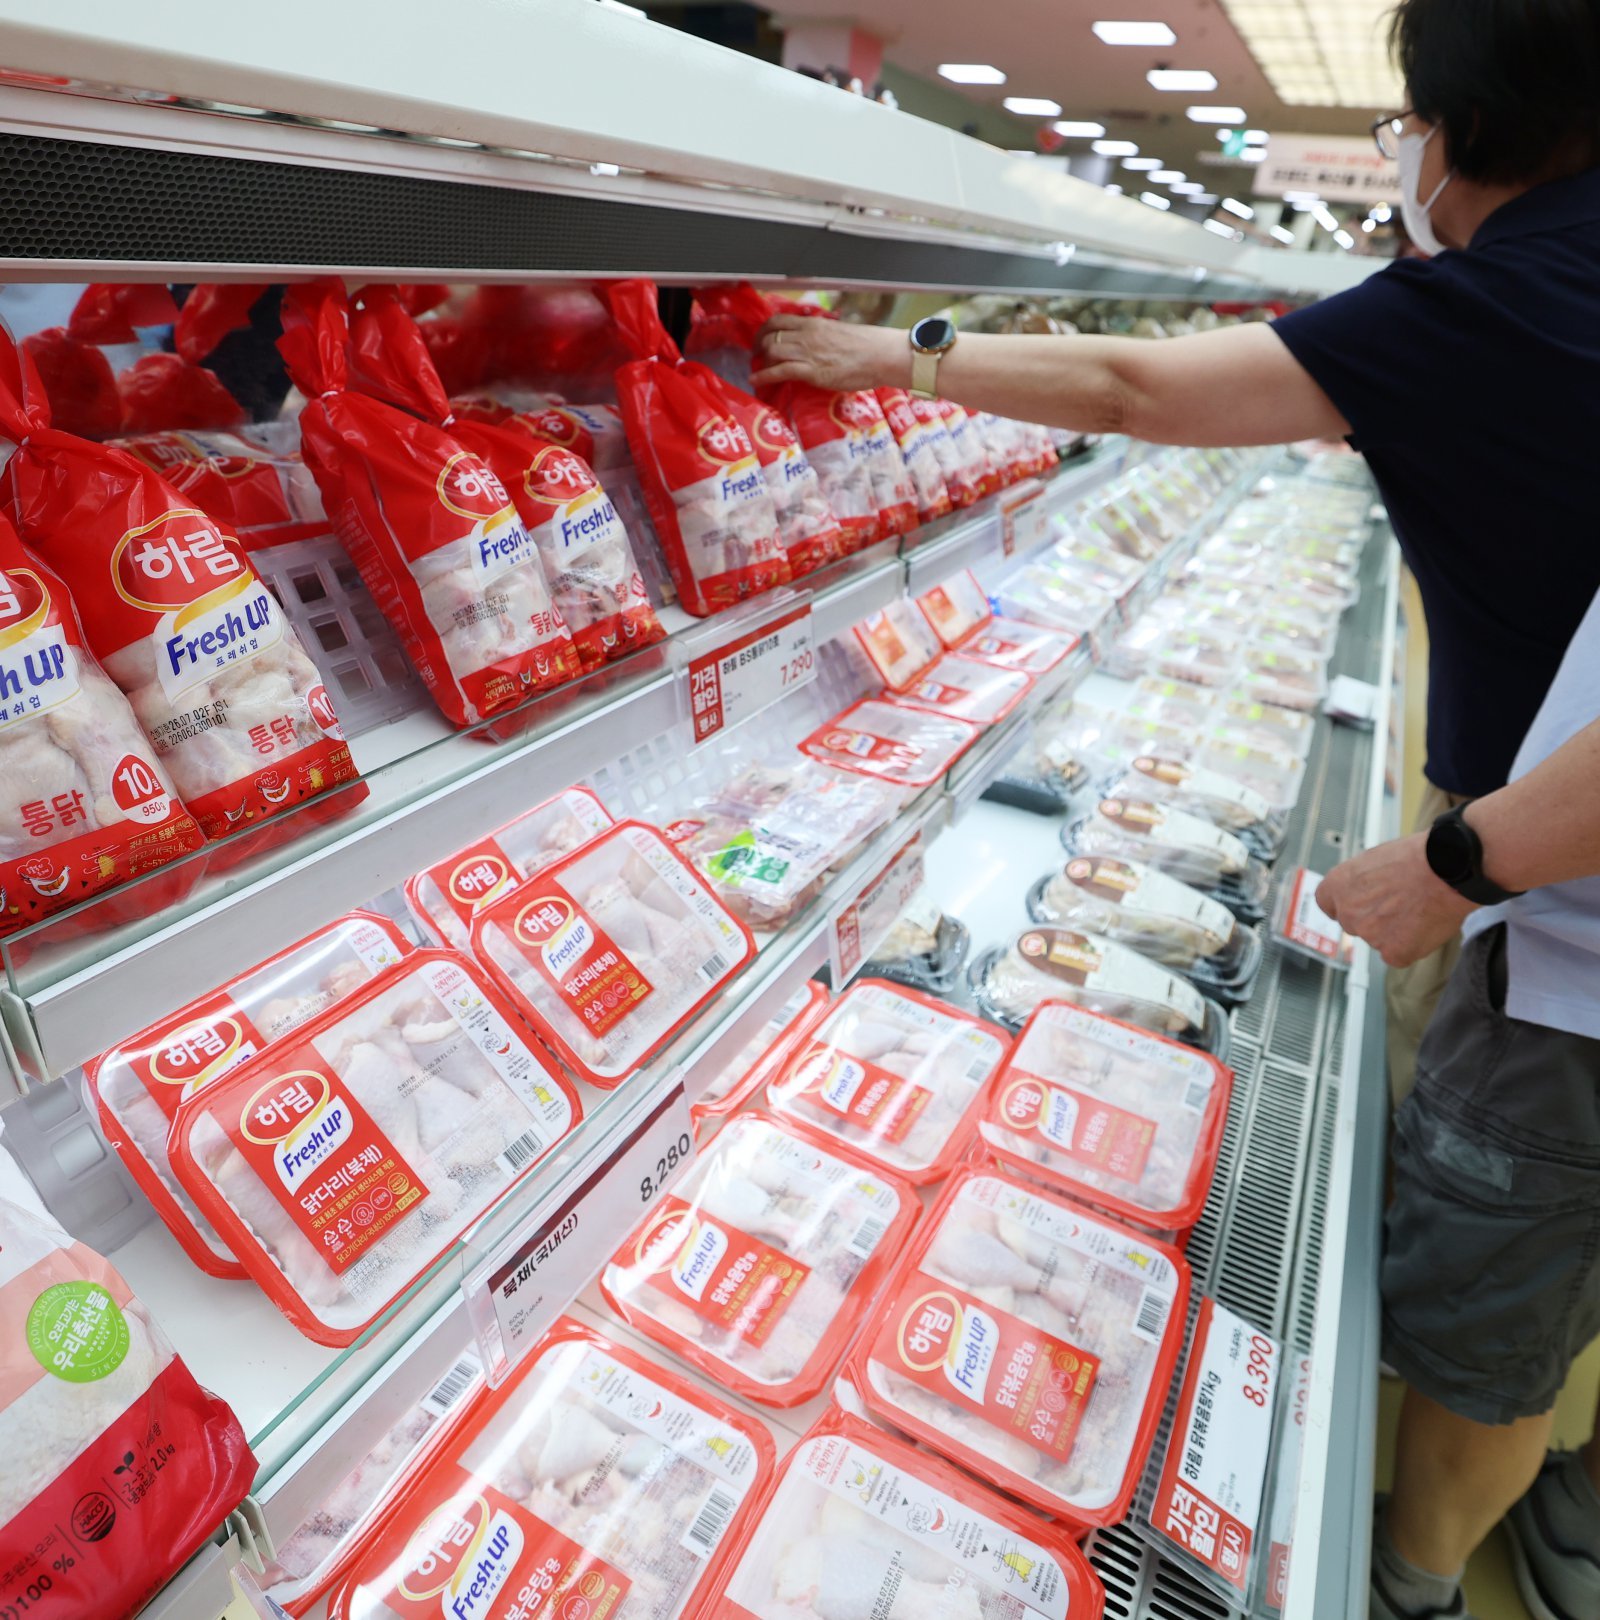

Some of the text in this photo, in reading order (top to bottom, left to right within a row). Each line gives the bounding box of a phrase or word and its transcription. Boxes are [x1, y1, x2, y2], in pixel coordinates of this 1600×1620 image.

[478, 525, 523, 568] Fresh
[561, 510, 604, 547] Fresh
[134, 527, 240, 584] 하림
[165, 594, 270, 677] Fresh UP
[24, 643, 65, 686] UP
[692, 663, 716, 693] 가격
[780, 650, 813, 686] 7,290
[693, 684, 718, 715] 할인
[699, 711, 718, 732] 행사
[248, 714, 299, 755] 통닭
[20, 788, 87, 837] 통닭
[458, 862, 498, 892] 하림
[523, 903, 565, 934] 하림
[549, 925, 586, 970] Fresh UP
[564, 950, 619, 997] 닭다리(북채)
[164, 1023, 225, 1067] 하림
[254, 1081, 315, 1126] 하림
[282, 1109, 342, 1178] Fresh UP
[300, 1143, 383, 1217] 닭다리(북채)
[640, 1132, 690, 1203] 8,280
[502, 1212, 579, 1299] 북채(국내산)
[680, 1231, 717, 1288] Fresh UP
[48, 1297, 80, 1343] 오리고기는
[53, 1289, 109, 1372] 우리축산물
[909, 1305, 953, 1354] 하림
[91, 1350, 122, 1377] SINCE
[955, 1316, 988, 1390] Fresh UP
[1242, 1335, 1274, 1408] 8,390
[1184, 1370, 1222, 1481] 하림 닭볶음탕1kg
[875, 1479, 889, 1503] Healthy
[1166, 1482, 1197, 1543] 가격
[80, 1501, 105, 1528] HACCP
[957, 1521, 970, 1541] Stress
[1189, 1499, 1220, 1561] 할인
[451, 1524, 508, 1620] Fresh UP
[1221, 1525, 1244, 1573] 행사
